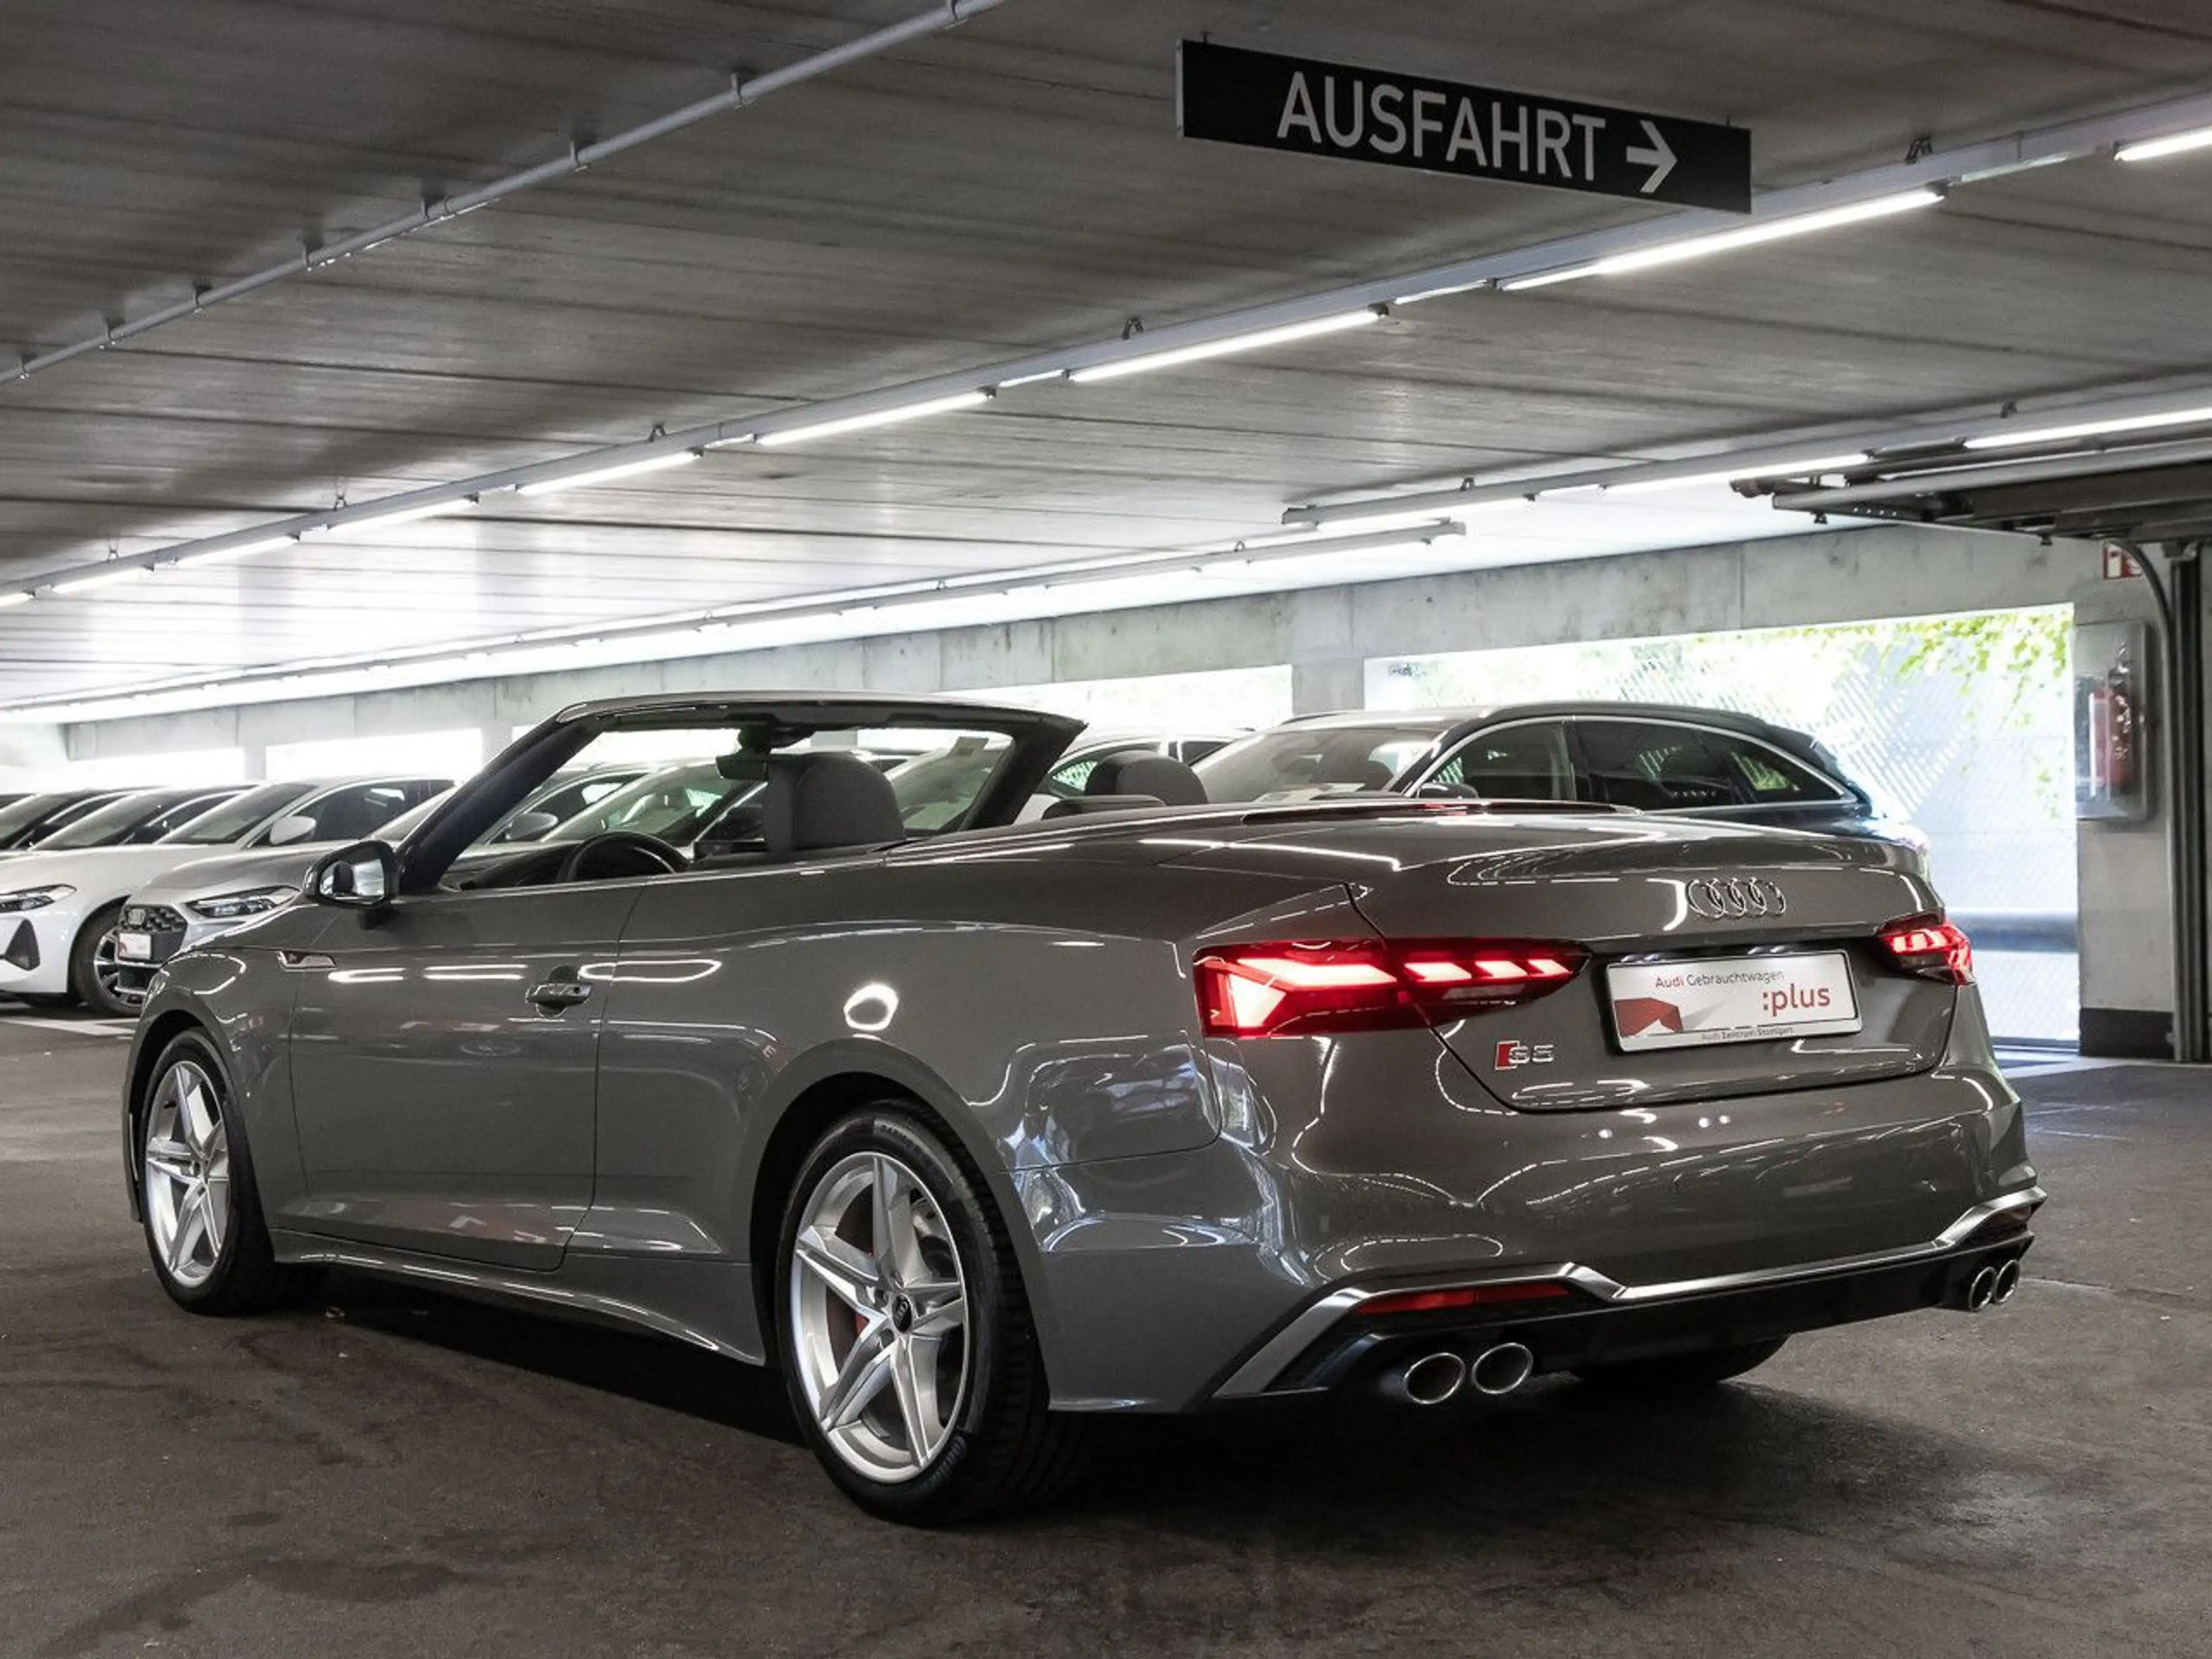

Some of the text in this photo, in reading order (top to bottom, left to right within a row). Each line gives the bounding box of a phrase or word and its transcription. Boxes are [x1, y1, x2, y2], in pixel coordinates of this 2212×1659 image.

[1277, 71, 1605, 181] AUSFAHRT
[1655, 971, 1784, 988] Audi Gebrauchtwagen
[1762, 984, 1831, 1017] :plus
